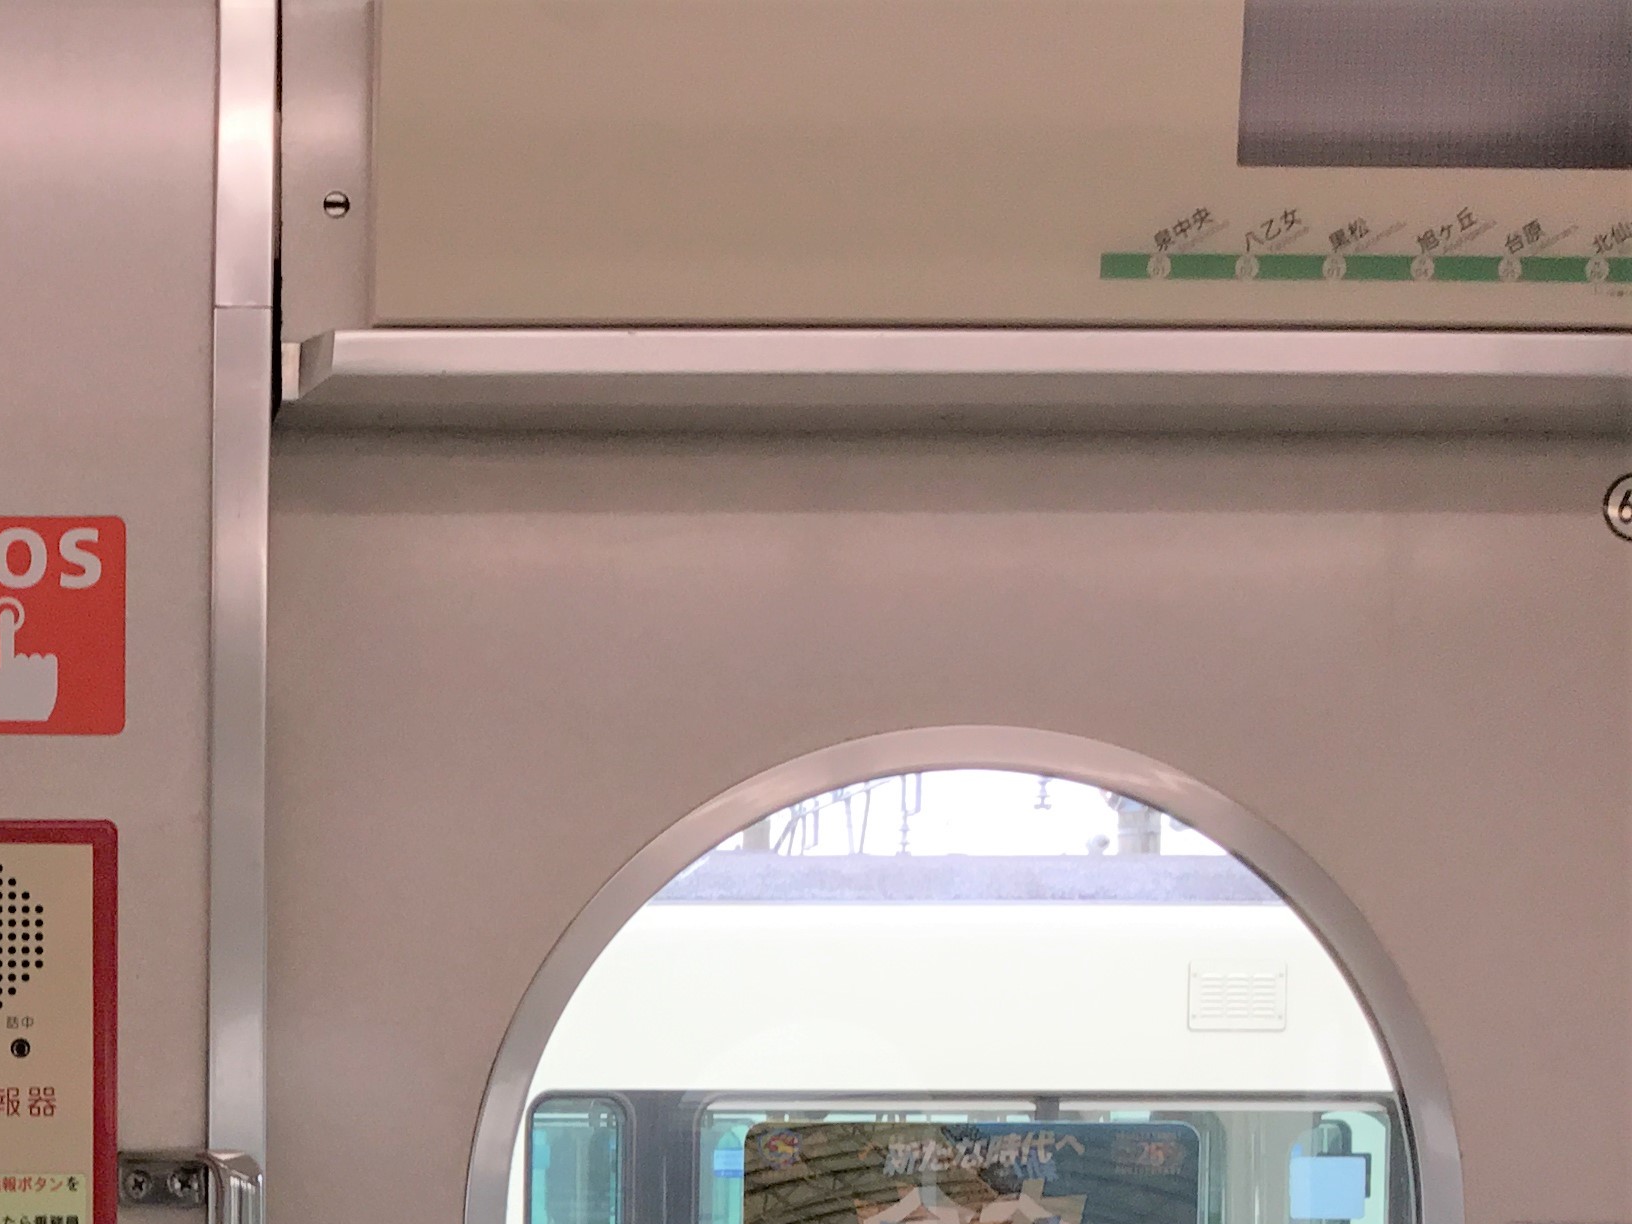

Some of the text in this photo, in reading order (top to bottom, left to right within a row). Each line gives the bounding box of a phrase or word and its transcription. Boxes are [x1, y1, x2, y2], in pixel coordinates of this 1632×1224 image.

[1245, 208, 1301, 252] 八乙女
[1504, 218, 1543, 254] 台原
[6, 1015, 34, 1029] 話中
